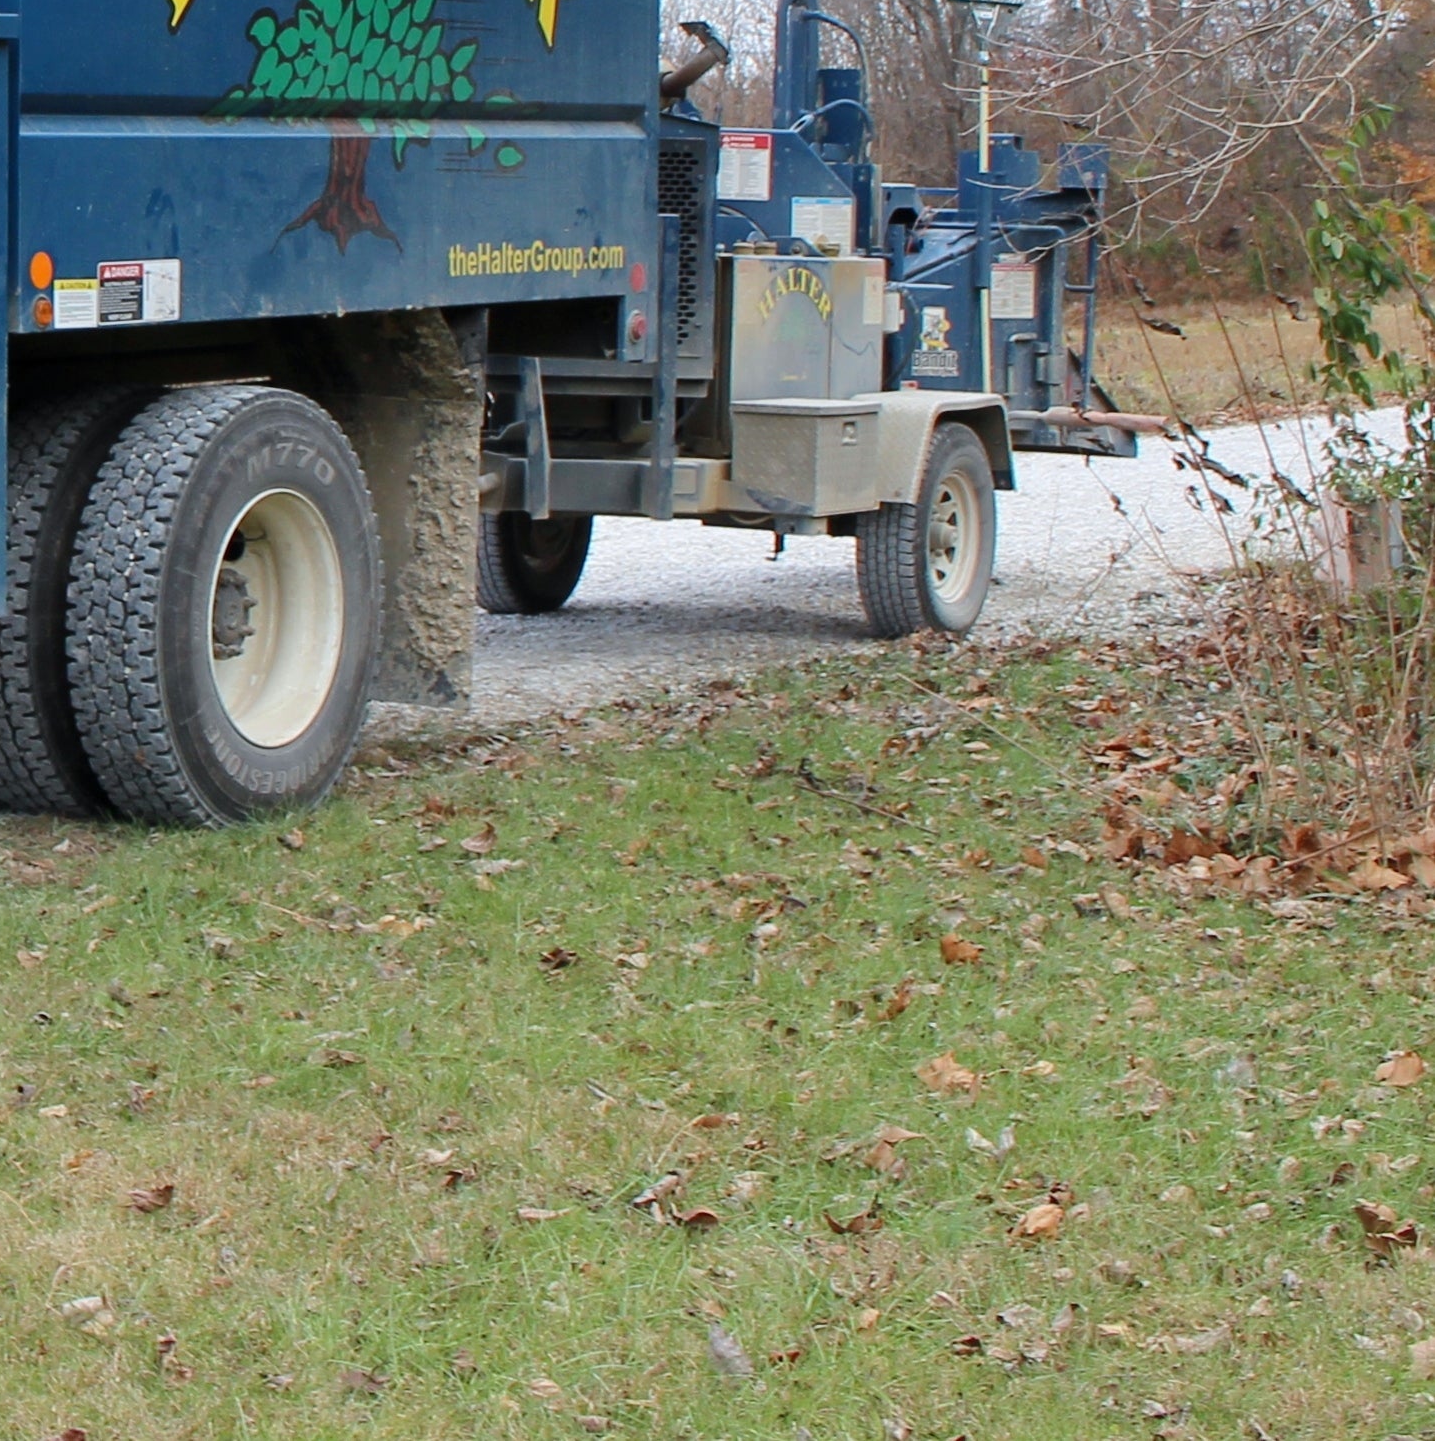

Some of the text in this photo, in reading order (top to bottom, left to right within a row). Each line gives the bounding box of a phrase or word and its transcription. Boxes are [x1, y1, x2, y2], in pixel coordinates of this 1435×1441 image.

[448, 239, 626, 279] theHalterGroup.com
[756, 266, 833, 321] HALTER
[246, 441, 337, 487] M770
